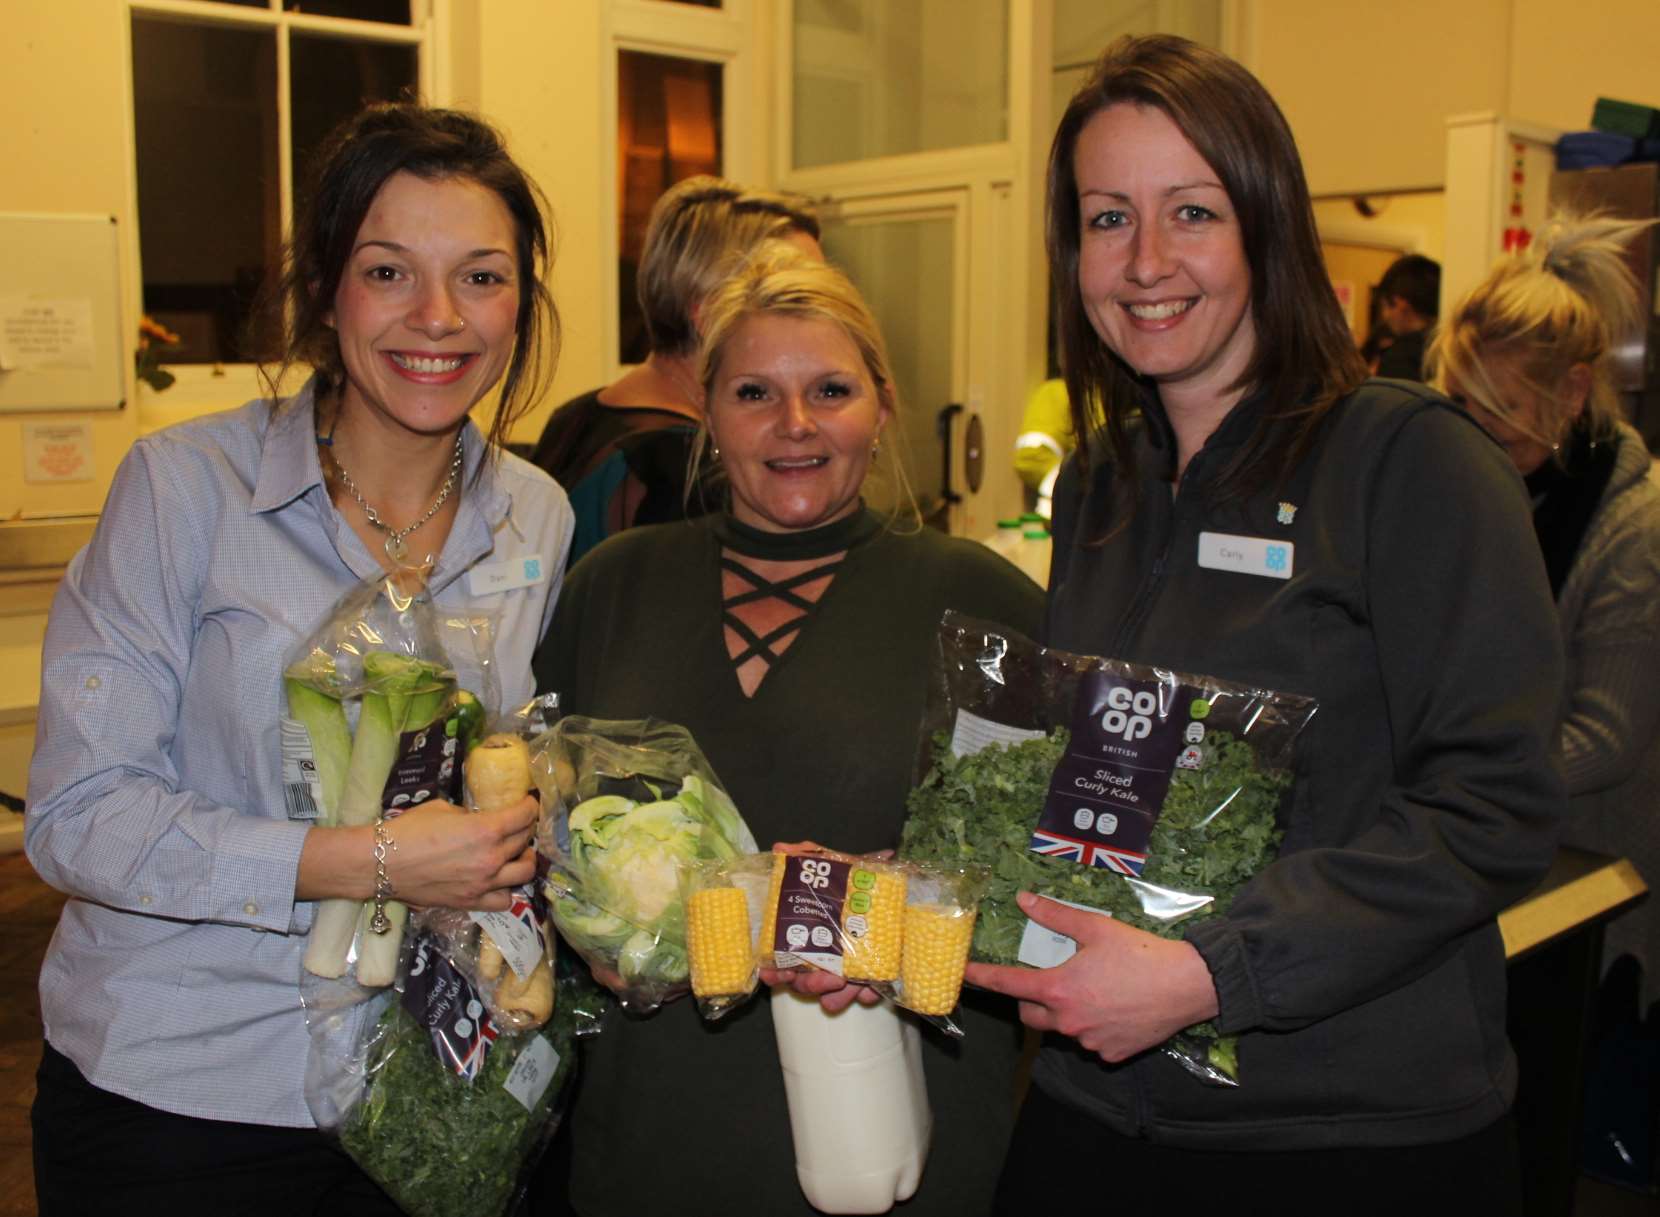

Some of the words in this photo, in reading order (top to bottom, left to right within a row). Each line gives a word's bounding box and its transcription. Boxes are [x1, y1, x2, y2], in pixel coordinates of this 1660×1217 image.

[1102, 744, 1139, 758] BRITISH
[1093, 769, 1133, 788] Sliced
[1074, 777, 1109, 796] Curly
[1109, 787, 1140, 803] Kale
[788, 895, 794, 903] 4
[428, 999, 451, 1026] Curly
